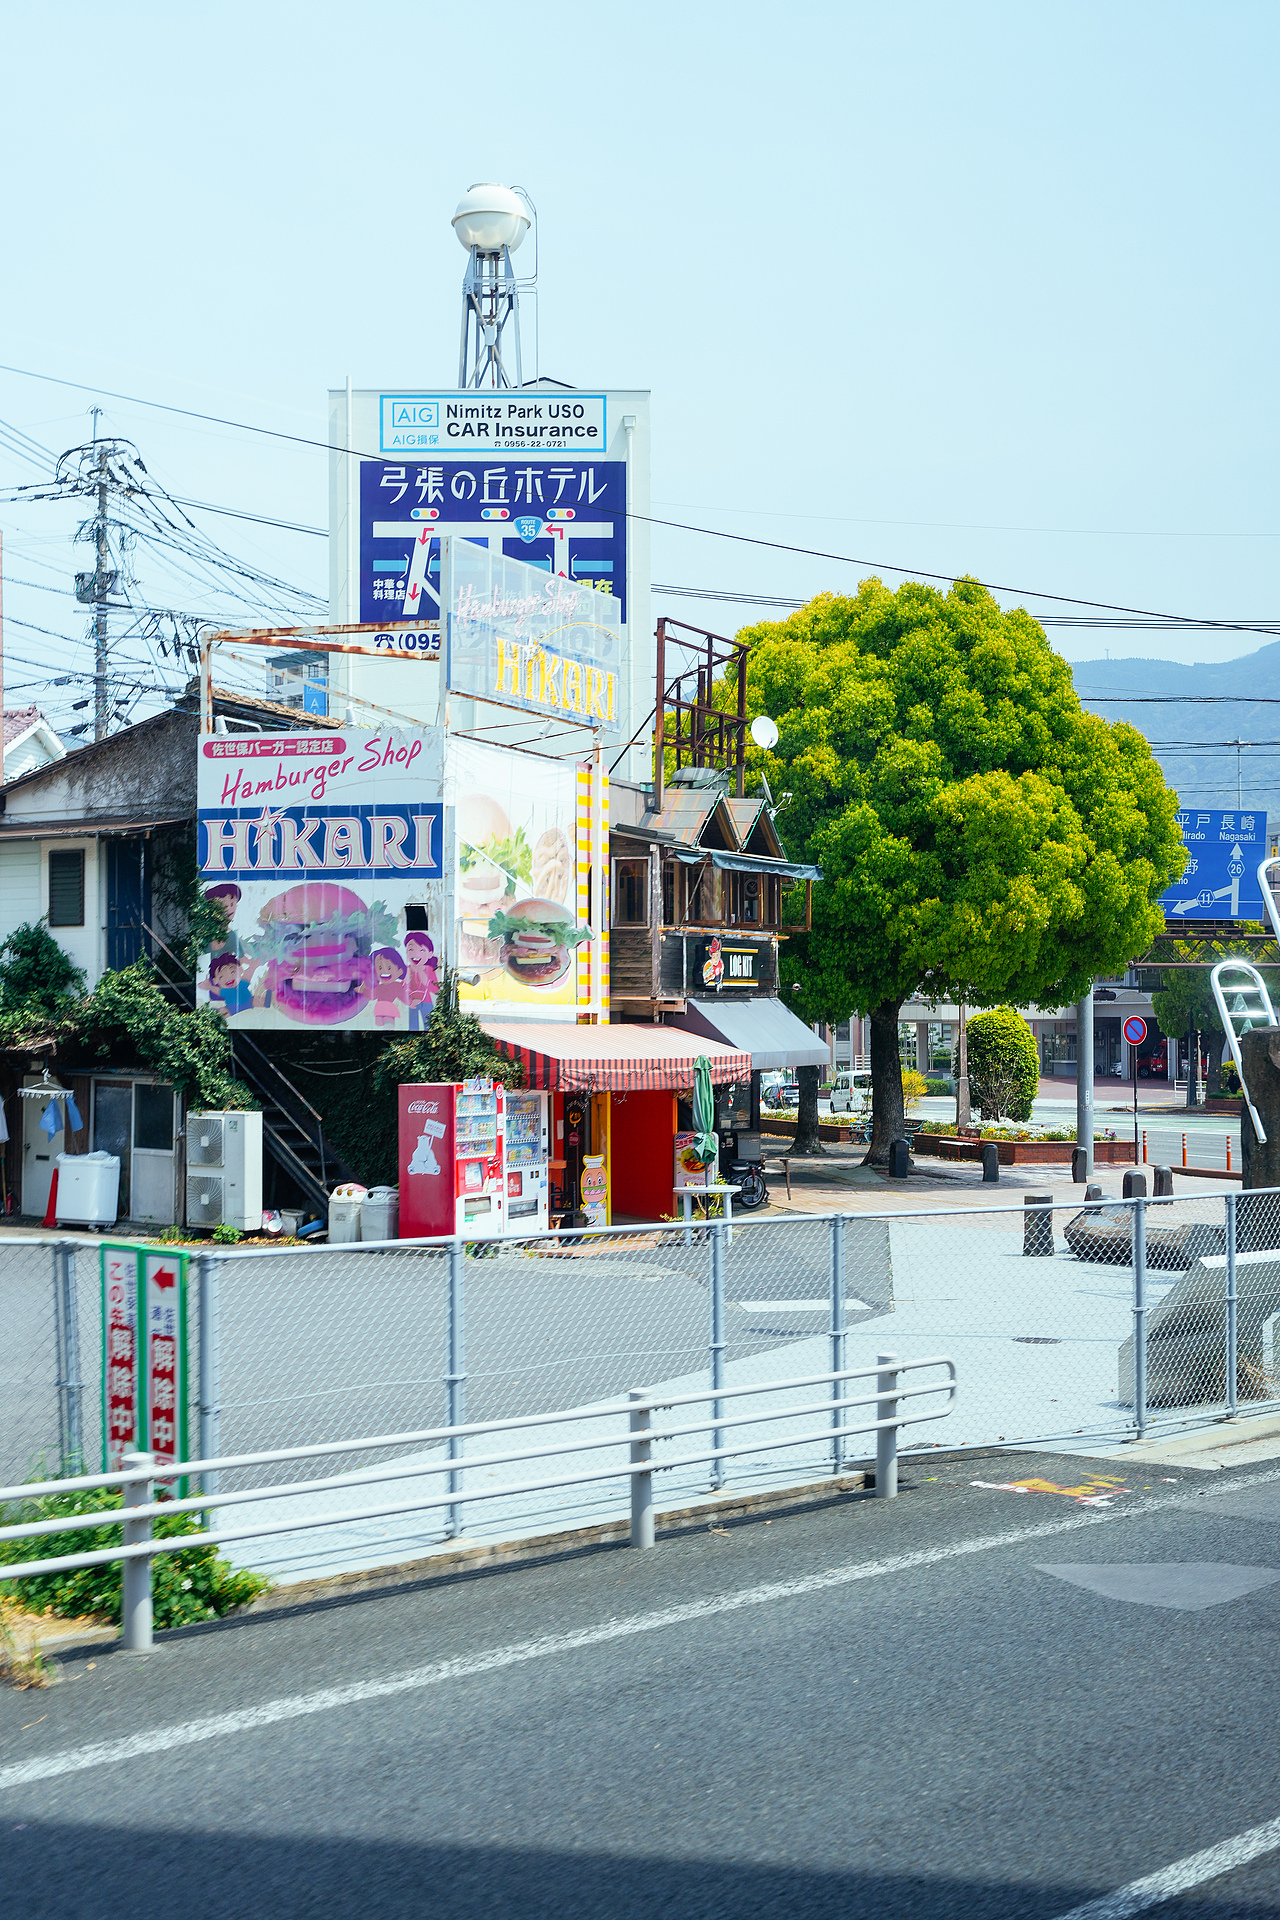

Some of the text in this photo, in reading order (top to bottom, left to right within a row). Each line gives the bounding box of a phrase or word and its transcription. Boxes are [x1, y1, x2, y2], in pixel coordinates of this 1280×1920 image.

[397, 407, 433, 423] AIG
[446, 404, 585, 419] Nimitz Park USO
[446, 422, 598, 437] CAR Insurance
[392, 435, 440, 445] AIG損保
[379, 466, 608, 504] 弓張の丘ホテル
[521, 524, 536, 537] 35
[373, 579, 396, 590] 中華
[373, 589, 406, 600] 料理店
[541, 579, 581, 622] Shop
[211, 739, 334, 756] 佐世保バーガー認定店
[219, 737, 422, 806] Hamburger Shop
[1220, 814, 1255, 831] 長崎
[1219, 831, 1256, 842] Nagasaki
[1230, 863, 1242, 874] 26
[1200, 893, 1211, 904] 11
[729, 954, 742, 977] LOG
